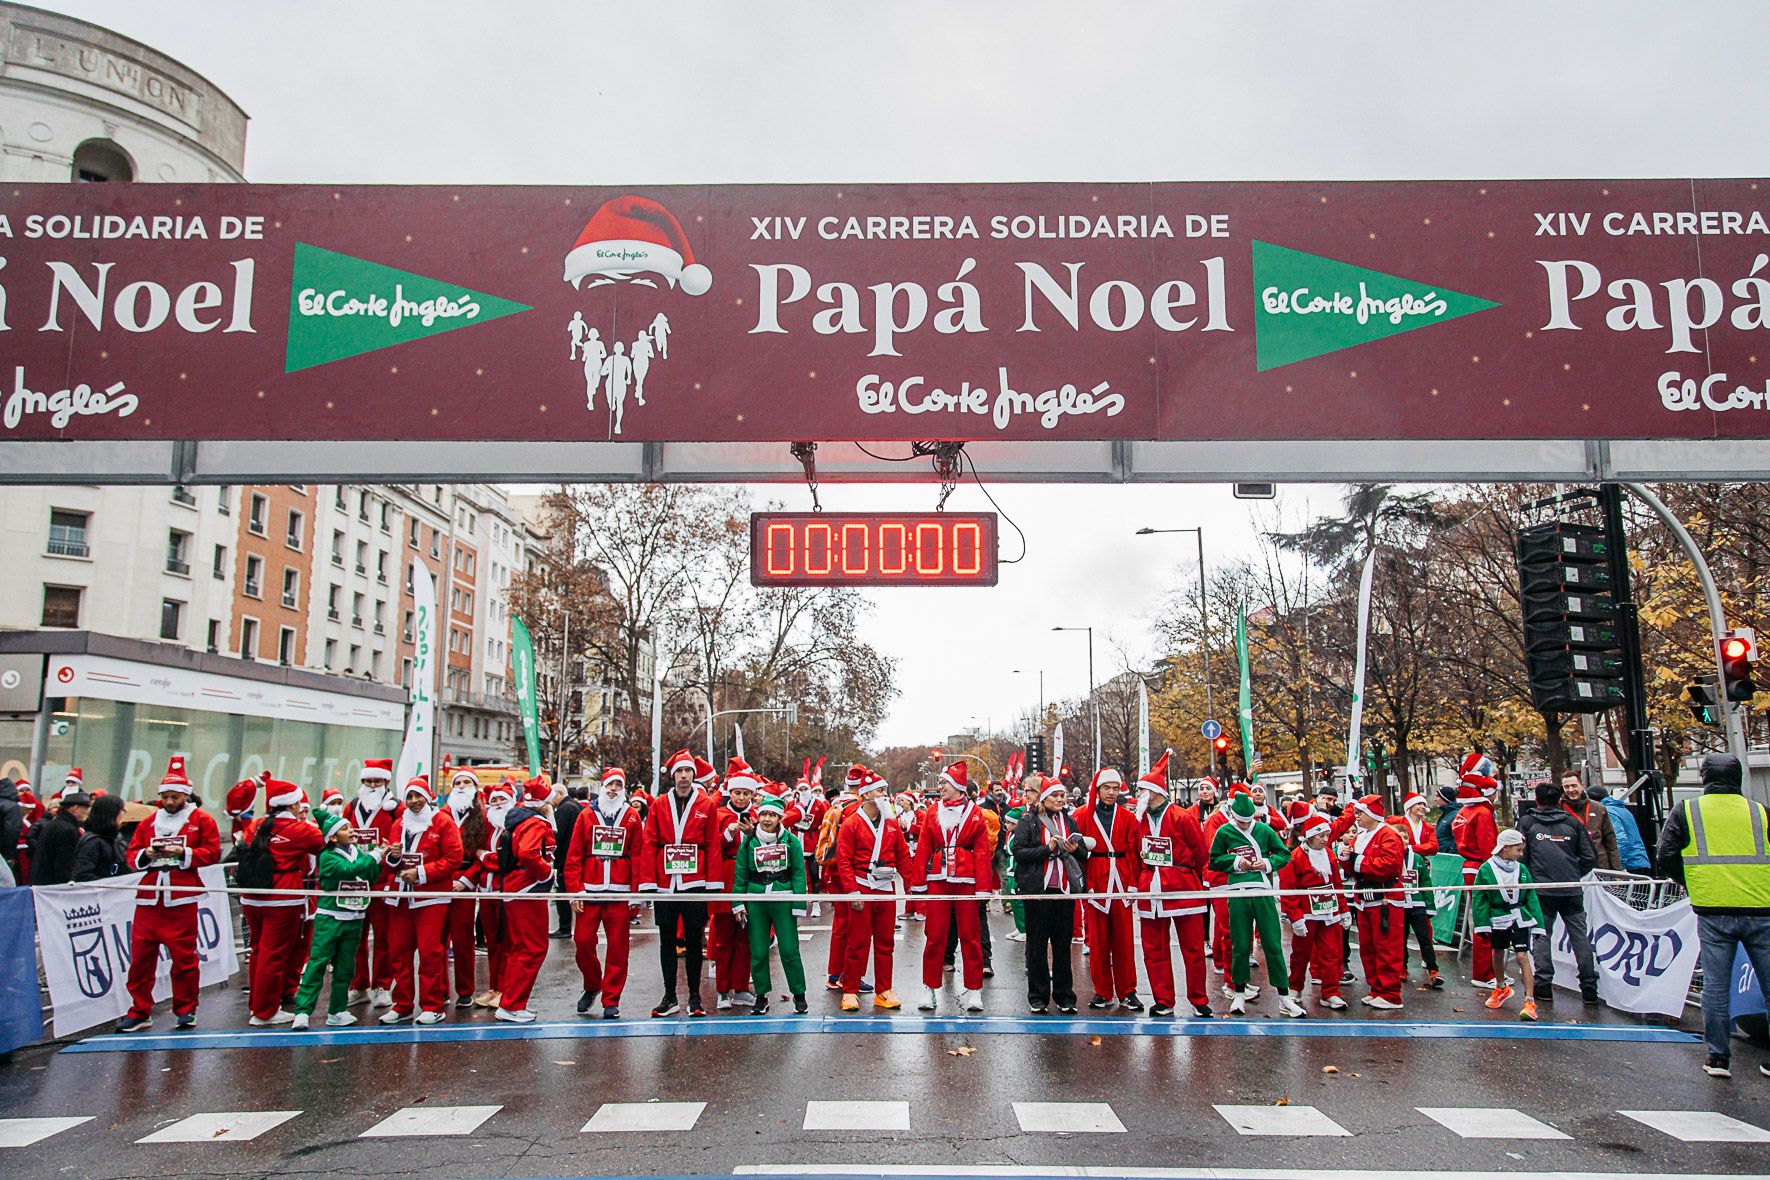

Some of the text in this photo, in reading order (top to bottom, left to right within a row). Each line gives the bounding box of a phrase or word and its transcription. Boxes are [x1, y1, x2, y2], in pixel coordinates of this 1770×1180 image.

[24, 214, 209, 240] SOLIDARIA
[219, 216, 265, 240] DE
[750, 214, 1230, 241] XIV CARRERA SOLIDARIA DE
[1533, 211, 1770, 237] XIV CARRERA
[38, 257, 257, 333] Noel
[298, 284, 480, 327] El Corte Inglés
[747, 256, 1235, 357] Papá Noel
[1262, 282, 1447, 325] El Corte Inglés
[1535, 253, 1770, 354] Papá
[3, 366, 139, 429] Inglés
[856, 366, 1125, 430] El Corte Inglés
[1657, 371, 1700, 412] El
[766, 522, 981, 576] 00:00:00
[601, 842, 614, 851] 901
[672, 860, 689, 869] 5304
